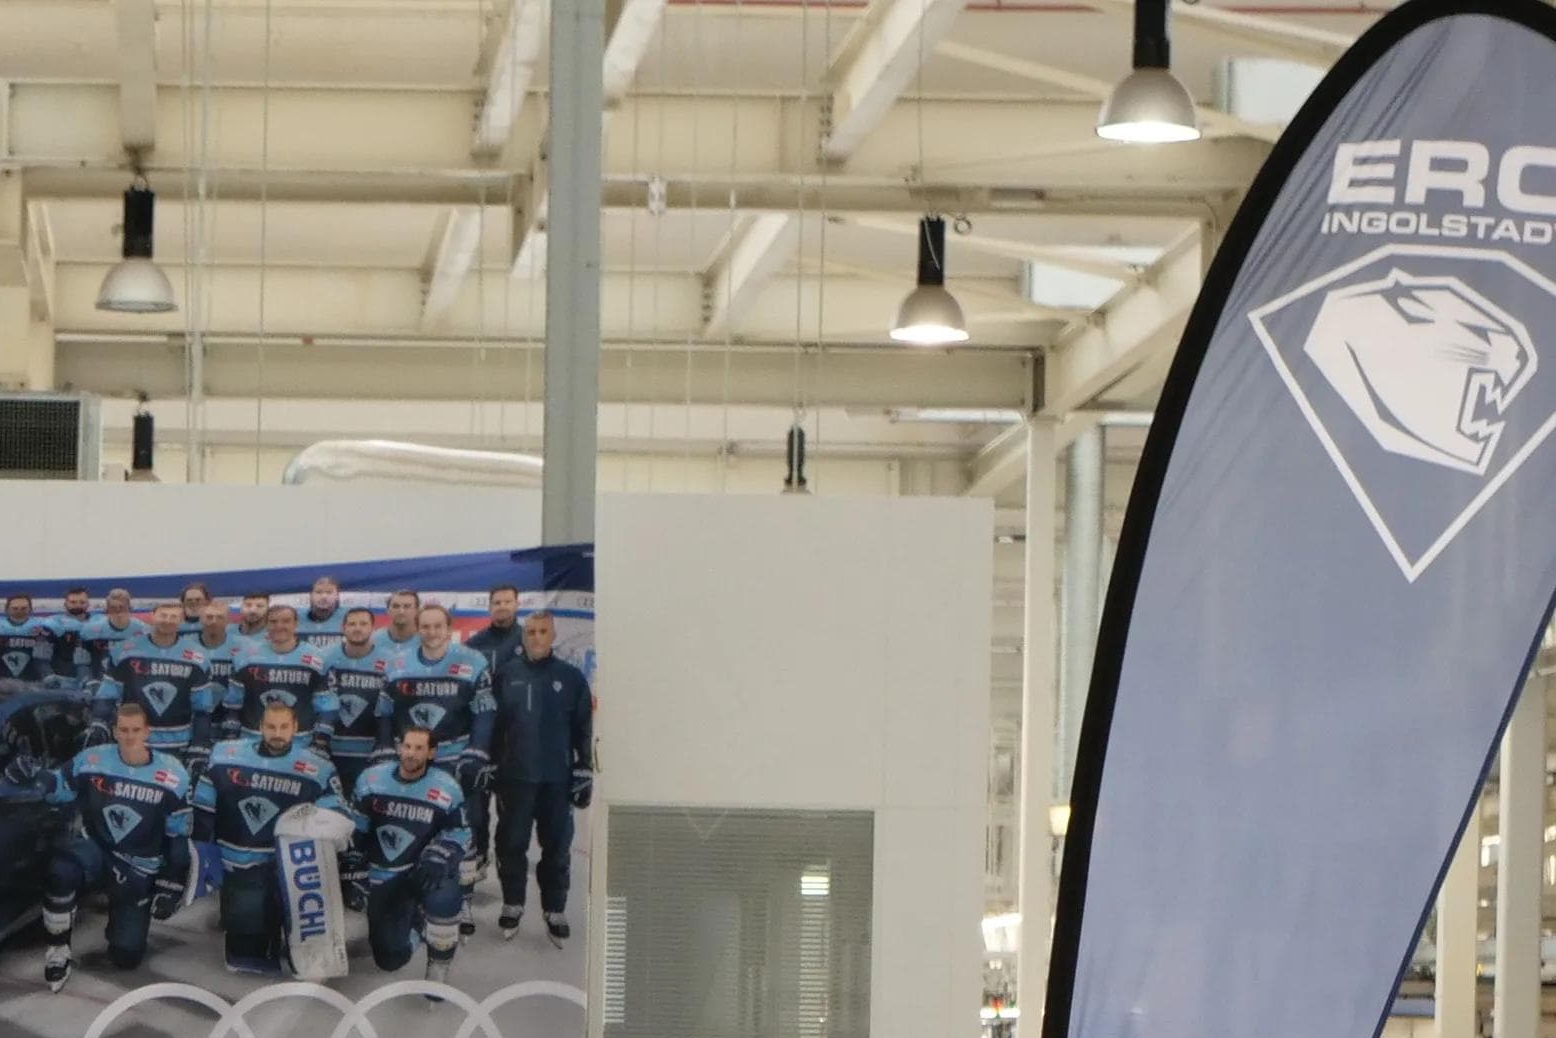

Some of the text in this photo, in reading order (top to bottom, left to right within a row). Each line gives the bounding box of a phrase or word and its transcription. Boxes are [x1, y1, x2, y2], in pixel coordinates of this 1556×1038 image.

[1327, 139, 1556, 214] ERC
[1320, 211, 1556, 245] INGOLSTAD
[151, 664, 193, 678] SATURN
[269, 669, 311, 686] SATURN
[415, 681, 459, 697] SATURN
[114, 782, 164, 804] SATURN
[251, 773, 303, 796] SATURN
[387, 802, 435, 823] SATURN
